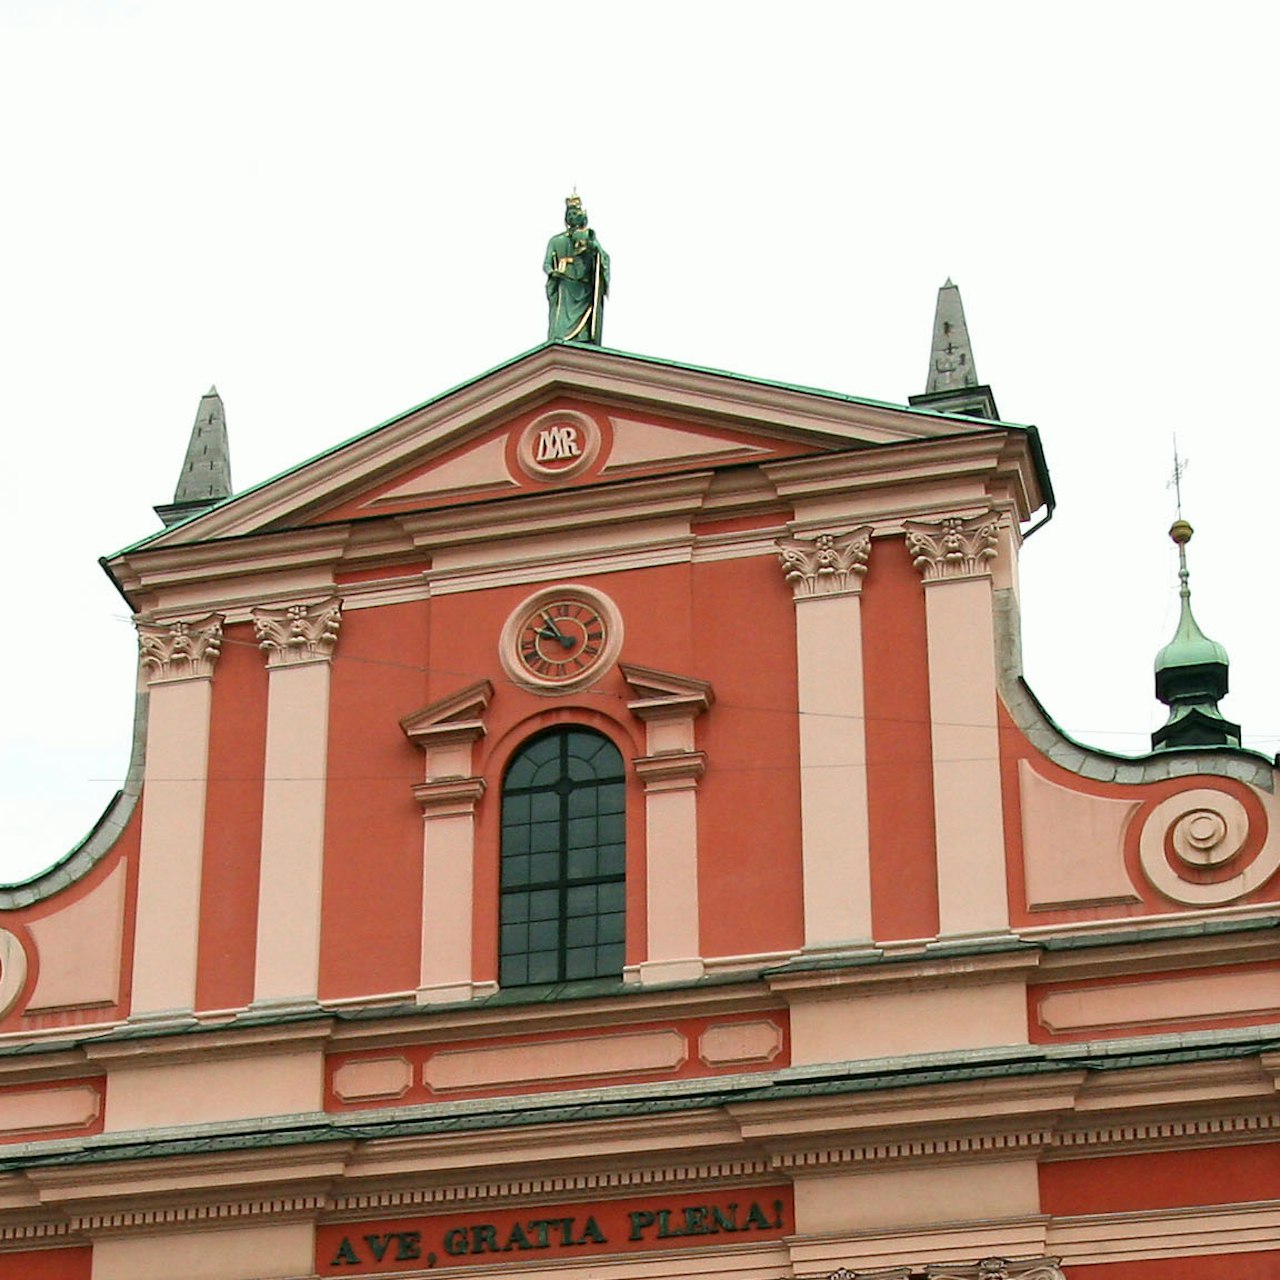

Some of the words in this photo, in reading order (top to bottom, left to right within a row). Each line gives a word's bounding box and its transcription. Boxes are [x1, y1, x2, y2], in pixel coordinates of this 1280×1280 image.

[330, 1231, 436, 1267] AVE,
[443, 1215, 608, 1257] GRATIA
[629, 1199, 784, 1241] PLENA!
